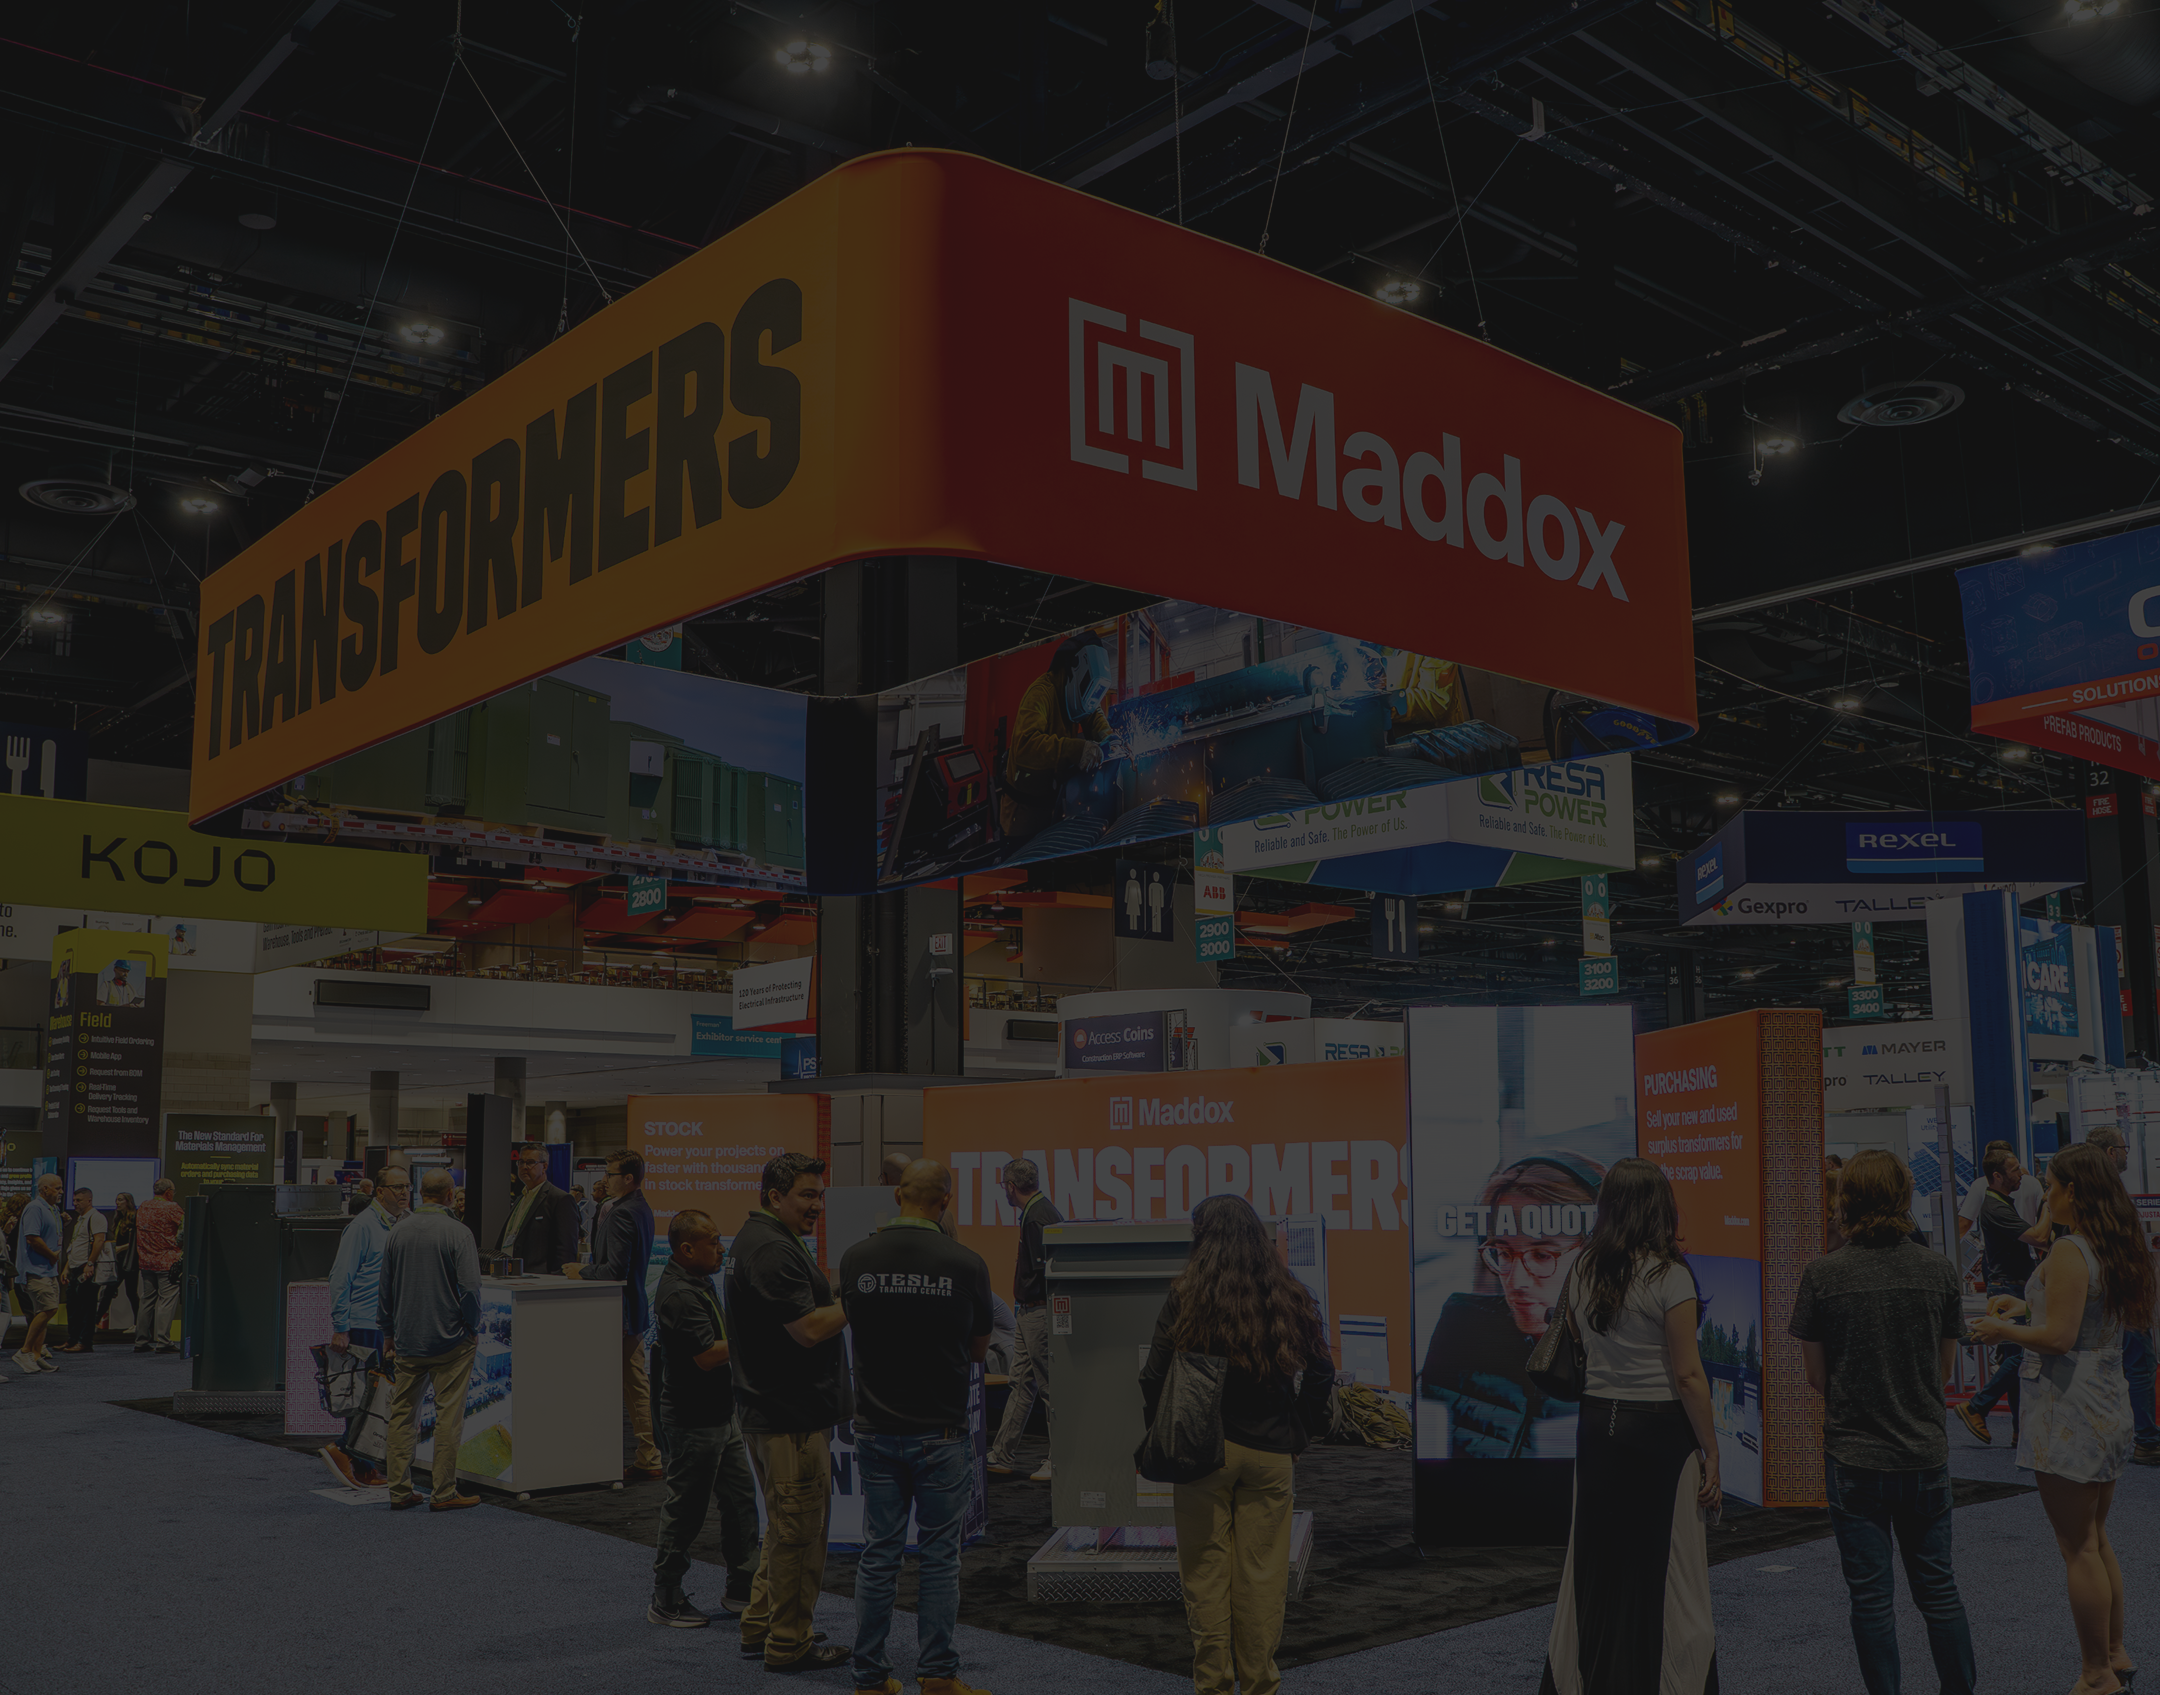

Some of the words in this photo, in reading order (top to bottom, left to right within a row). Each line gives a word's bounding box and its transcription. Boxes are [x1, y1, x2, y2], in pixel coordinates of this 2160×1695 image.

[1235, 361, 1630, 604] Maddox
[208, 278, 803, 761] TRANSFORMERS
[2043, 716, 2078, 739] PREFAB
[2079, 723, 2122, 753] PRODUCTS
[1523, 761, 1605, 800] RESA
[2089, 770, 2110, 787] 32
[1304, 790, 1407, 825] POWER
[1524, 789, 1607, 828] POWER
[2092, 796, 2111, 807] FIRE
[2092, 805, 2113, 816] HOSE
[1254, 836, 1288, 853] Reliable
[1290, 833, 1306, 848] and
[1308, 830, 1330, 845] Safe.
[1332, 826, 1348, 841] The
[1351, 822, 1379, 838] Power
[1381, 819, 1391, 833] of
[1393, 816, 1408, 831] Us.
[1479, 813, 1511, 832] Reliable
[1513, 820, 1527, 834] and
[1528, 821, 1548, 838] Safe.
[1550, 824, 1563, 840] The
[1564, 827, 1587, 844] Power
[1588, 833, 1596, 846] of
[1597, 834, 1609, 848] Us.
[81, 834, 276, 892] KOJO
[632, 888, 661, 908] 2800
[1203, 885, 1226, 900] ABB
[1738, 898, 1808, 919] Gexpro
[291, 928, 303, 945] Tools
[1199, 921, 1230, 938] 2900
[935, 935, 947, 950] EXIT
[1200, 940, 1231, 957] 3000
[1584, 961, 1612, 976] 3100
[1584, 977, 1614, 991] 3200
[1669, 976, 1679, 985] 36
[2027, 960, 2070, 994] CARE
[739, 988, 749, 998] 120
[749, 986, 765, 996] Years
[765, 984, 772, 994] of
[772, 980, 802, 992] Protecting
[1851, 989, 1879, 1001] 3300
[739, 998, 765, 1010] Electrical
[765, 993, 804, 1006] Infrastructure
[1852, 1002, 1880, 1014] 3400
[80, 1012, 112, 1028] Field
[91, 1035, 114, 1044] Intuitive
[115, 1036, 128, 1044] Field
[129, 1037, 155, 1046] Ordering
[696, 1032, 734, 1042] Exhibitor
[735, 1034, 764, 1044] service
[765, 1036, 782, 1044] cent
[1088, 1031, 1121, 1046] Access
[1123, 1026, 1154, 1042] Coins
[1325, 1043, 1370, 1060] RESA
[1882, 1040, 1946, 1055] MAYER
[90, 1052, 110, 1060] Mobile
[110, 1052, 122, 1061] App
[803, 1057, 816, 1070] PS
[1082, 1053, 1112, 1063] Construction
[1113, 1052, 1122, 1061] ERP
[1123, 1051, 1146, 1060] Software
[89, 1068, 113, 1077] Request
[114, 1069, 128, 1077] from
[1863, 1071, 1946, 1085] TALLEY
[89, 1083, 117, 1091] Real-Time
[1644, 1065, 1718, 1096] PURCHASING
[1824, 1075, 1848, 1091] pro
[88, 1092, 112, 1101] Delivery
[112, 1093, 137, 1102] Tracking
[88, 1105, 111, 1114] Request
[127, 1106, 138, 1114] and
[1139, 1096, 1234, 1126] Maddox
[1646, 1109, 1662, 1128] Sell
[1662, 1111, 1681, 1130] your
[1682, 1109, 1698, 1126] new
[1699, 1104, 1716, 1124] and
[1716, 1101, 1738, 1122] used
[87, 1115, 121, 1123] Warehouse
[121, 1115, 150, 1125] Inventory
[178, 1130, 193, 1140] The
[194, 1130, 212, 1140] New
[213, 1131, 249, 1141] Standard
[250, 1131, 264, 1141] For
[644, 1121, 703, 1136] STOCK
[175, 1141, 214, 1151] Materials
[215, 1141, 266, 1153] Management
[644, 1144, 683, 1157] Power
[685, 1147, 712, 1159] your
[715, 1144, 766, 1159] projects
[768, 1146, 785, 1156] on
[1647, 1136, 1677, 1157] surplus
[1678, 1133, 1730, 1153] transformers
[1731, 1131, 1743, 1150] for
[181, 1162, 220, 1171] Automatically
[220, 1163, 234, 1172] sync
[234, 1163, 259, 1171] material
[644, 1161, 680, 1173] faster
[683, 1161, 708, 1173] with
[1675, 1165, 1699, 1184] scrap
[1700, 1161, 1723, 1181] value.
[213, 1171, 245, 1180] purchasing
[644, 1178, 656, 1190] in
[658, 1178, 692, 1191] stock
[694, 1178, 763, 1191] transforme
[950, 1139, 1410, 1231] TRANSFORMER
[2136, 1198, 2160, 1206] SERIE
[1437, 1205, 1491, 1237] GET
[1495, 1205, 1518, 1236] A
[1521, 1204, 1599, 1239] QUOT
[1724, 1215, 1750, 1226] Maddox.com
[876, 1273, 953, 1289] TESLA
[879, 1286, 917, 1295] TRAINING
[920, 1287, 953, 1297] CENTER
